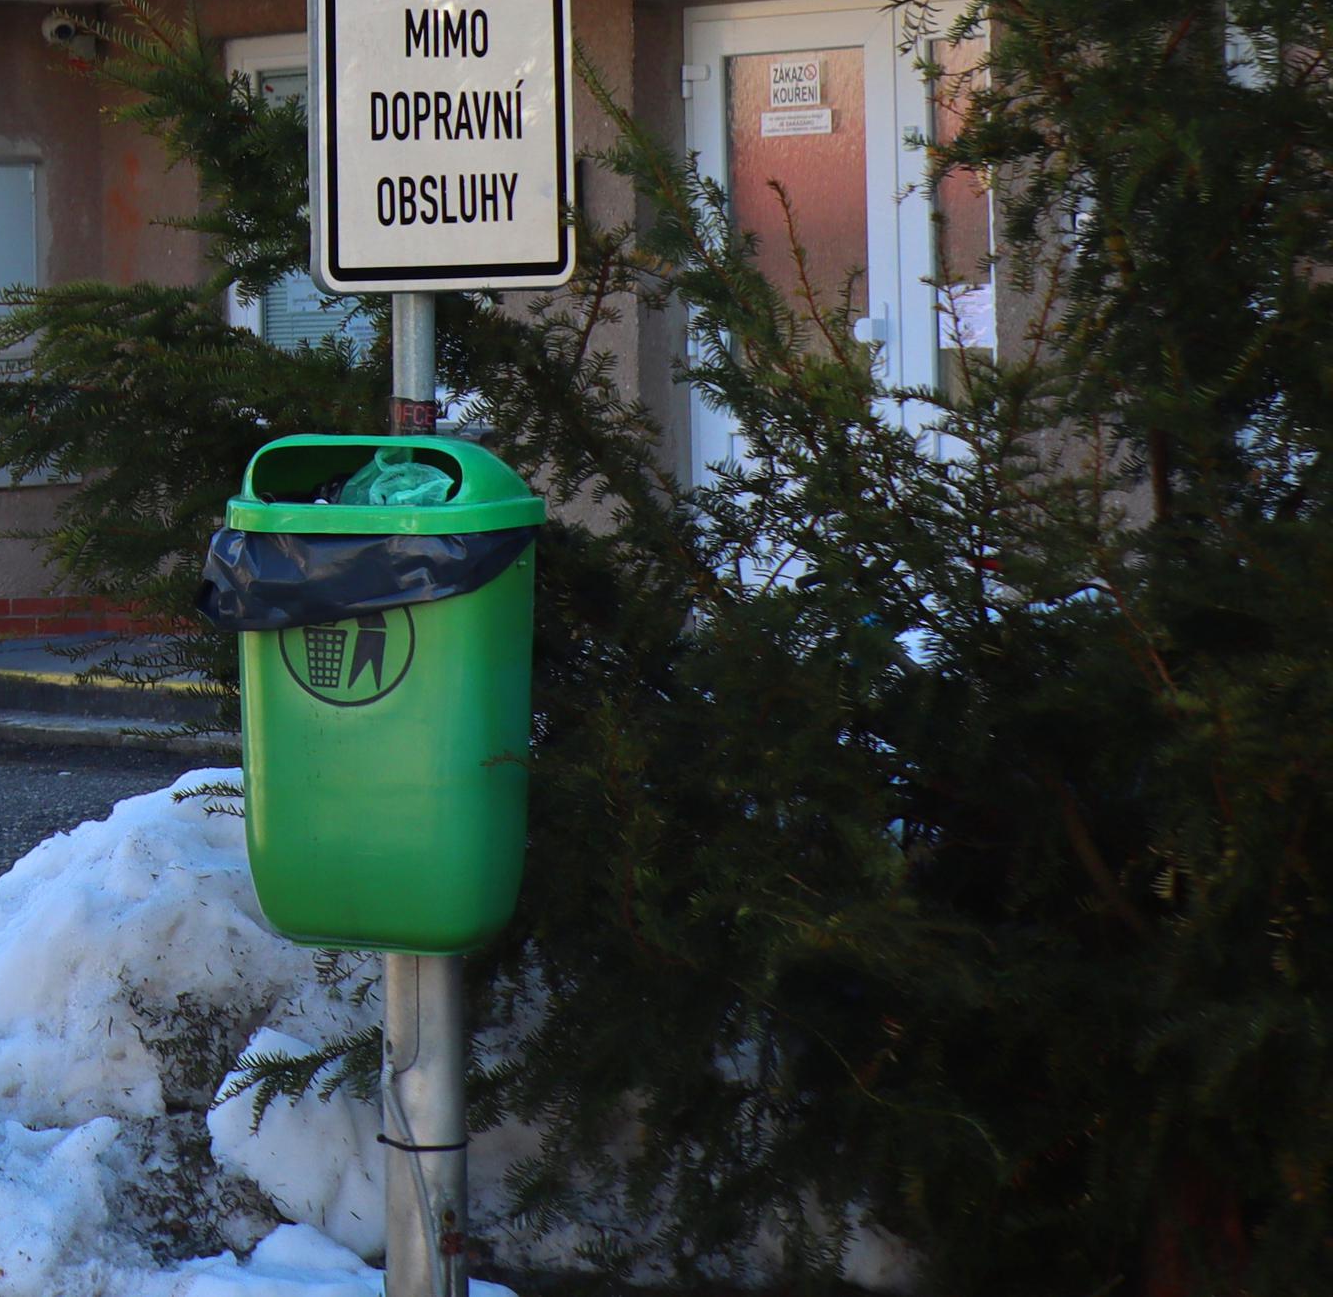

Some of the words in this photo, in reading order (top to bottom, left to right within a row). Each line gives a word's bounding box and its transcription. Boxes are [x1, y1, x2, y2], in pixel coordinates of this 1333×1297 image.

[405, 8, 488, 58] MIMO
[773, 64, 804, 84] ZÁKAZ
[773, 81, 818, 104] KOUŘENÍ
[370, 79, 524, 141] DOPRAVNÍ
[377, 172, 518, 227] OBSLUHY
